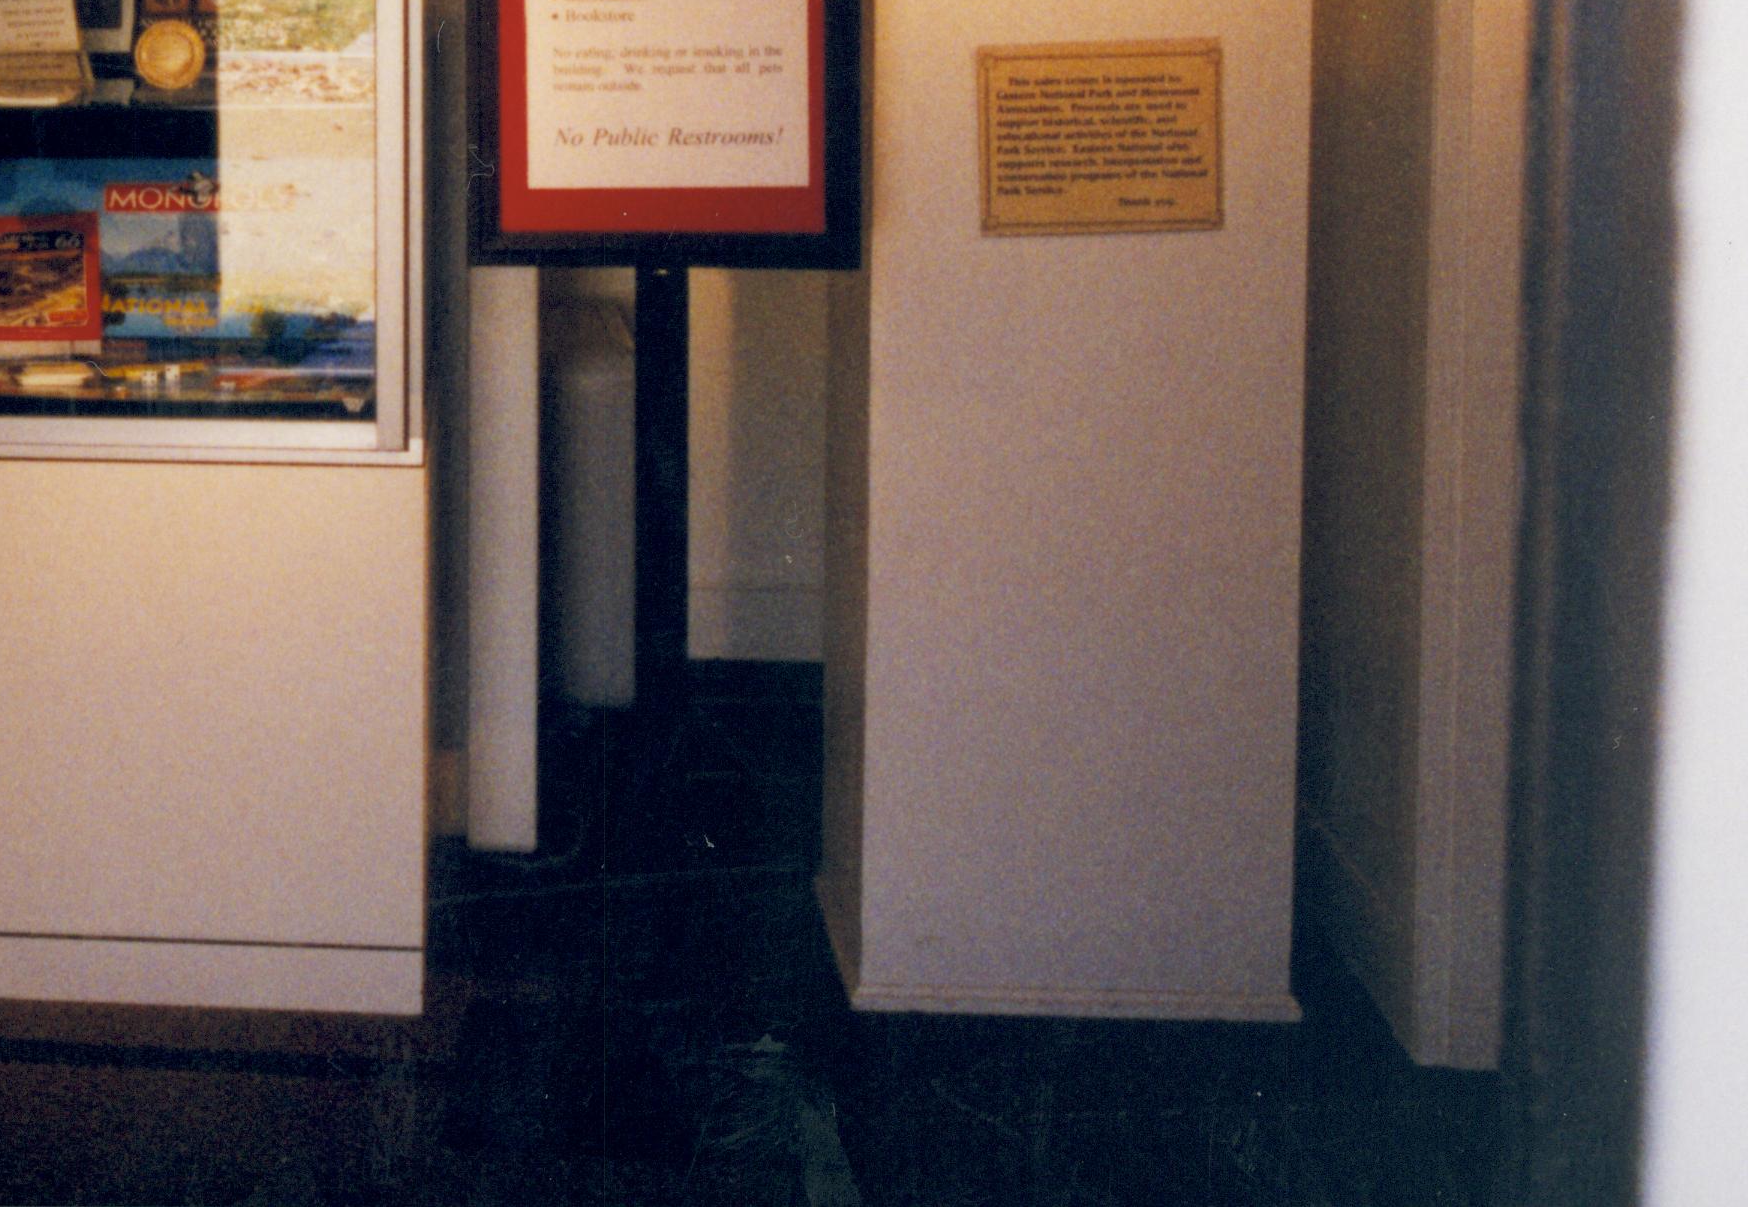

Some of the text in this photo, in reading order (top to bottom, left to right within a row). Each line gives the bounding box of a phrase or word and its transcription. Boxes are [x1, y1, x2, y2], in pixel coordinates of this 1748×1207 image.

[565, 10, 635, 22] Bookstore
[764, 46, 782, 57] the
[704, 63, 726, 74] that
[735, 62, 750, 73] all
[556, 126, 784, 146] No Public Restrooms!
